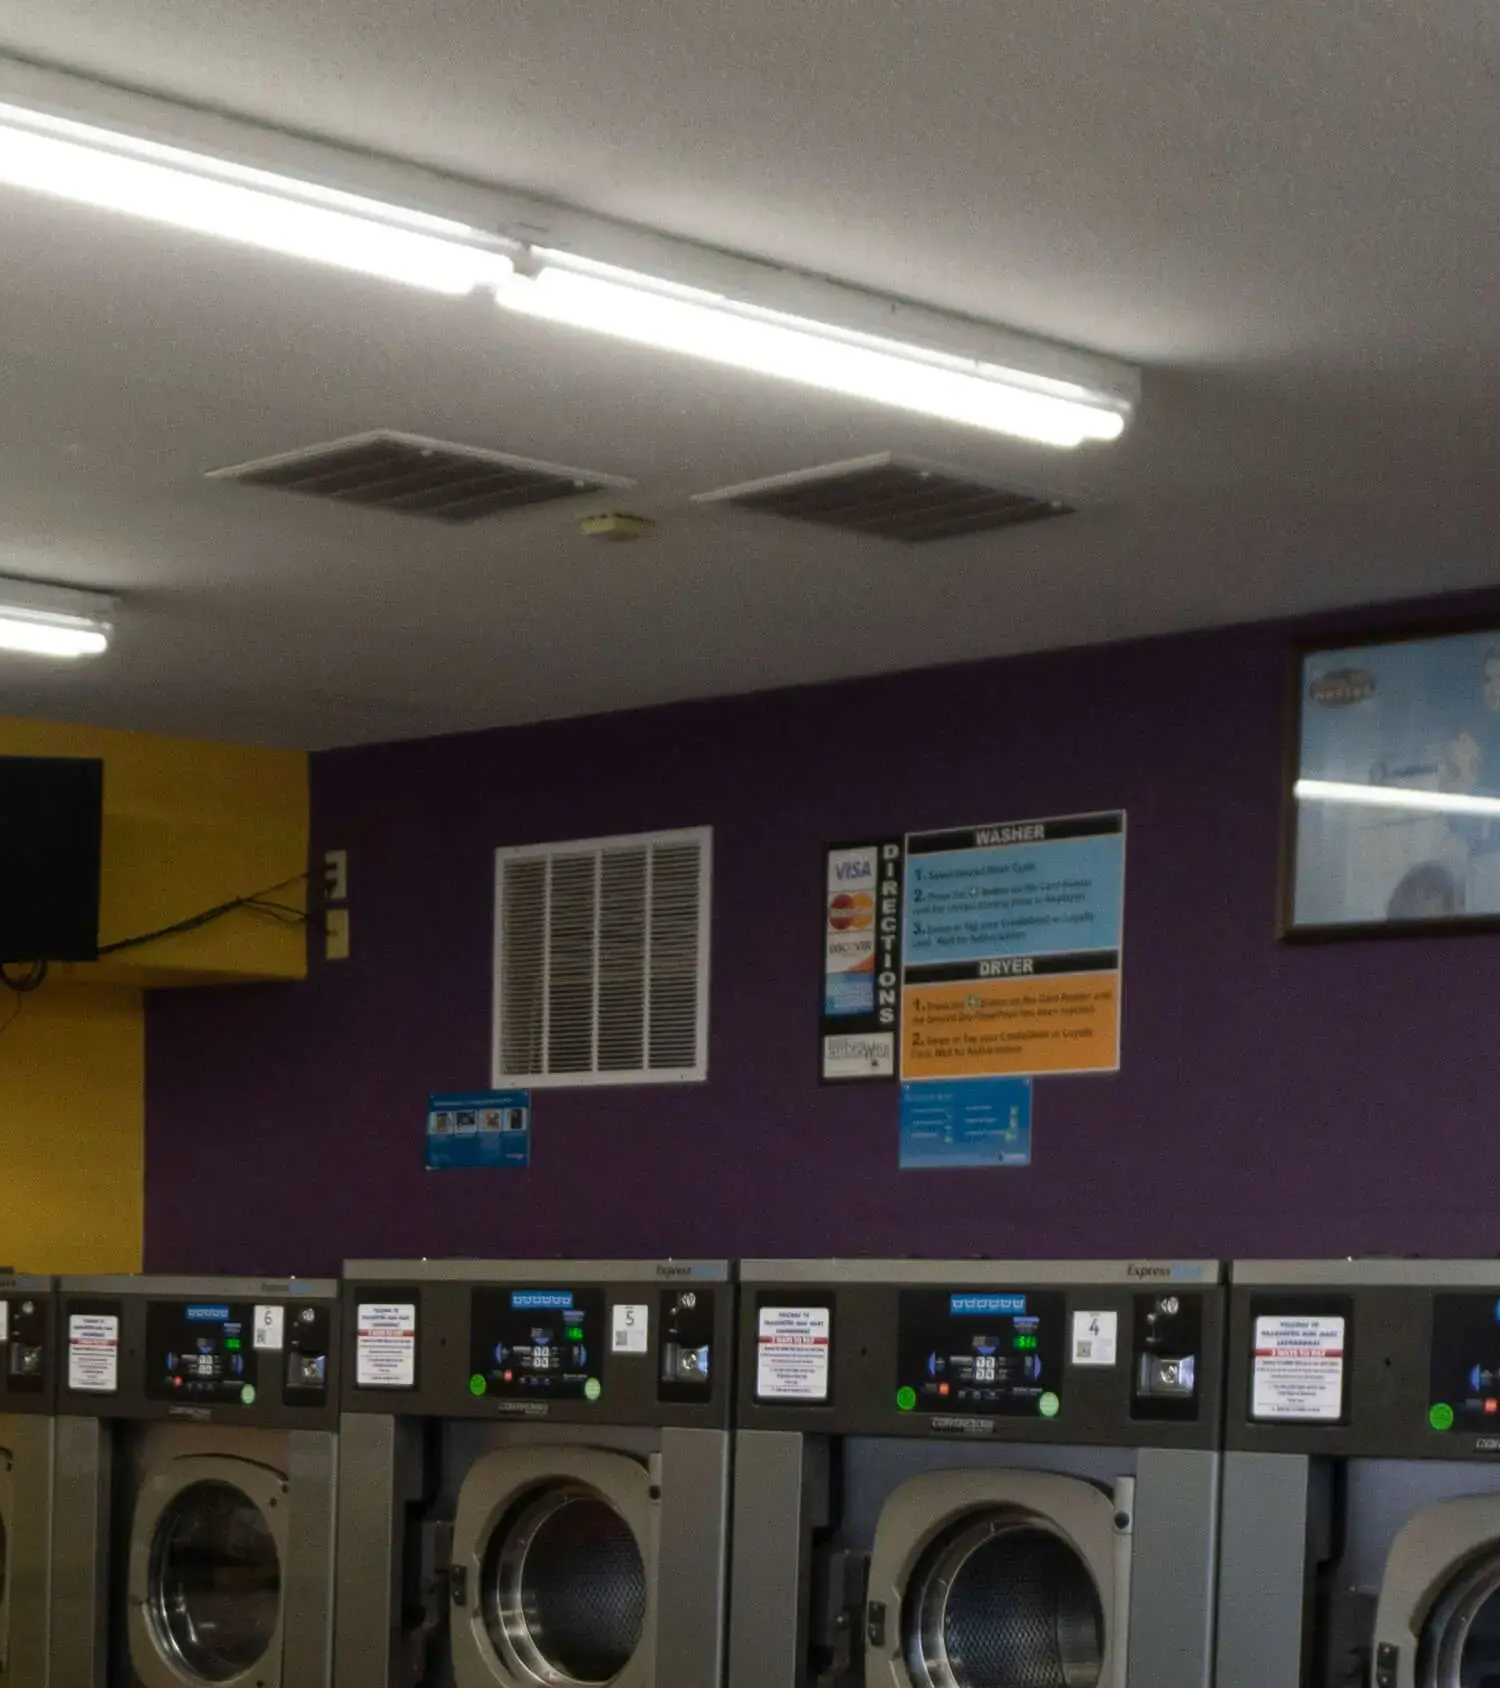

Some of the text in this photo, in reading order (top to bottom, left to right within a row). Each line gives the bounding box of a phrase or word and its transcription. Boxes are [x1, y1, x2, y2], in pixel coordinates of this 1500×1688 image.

[976, 824, 1046, 846] WASHER
[835, 860, 872, 882] VISA
[878, 844, 899, 1024] DIRECTIONS
[979, 958, 1034, 977] DRYER
[264, 1310, 273, 1326] 6
[626, 1310, 635, 1326] 5
[1090, 1319, 1100, 1337] 4
